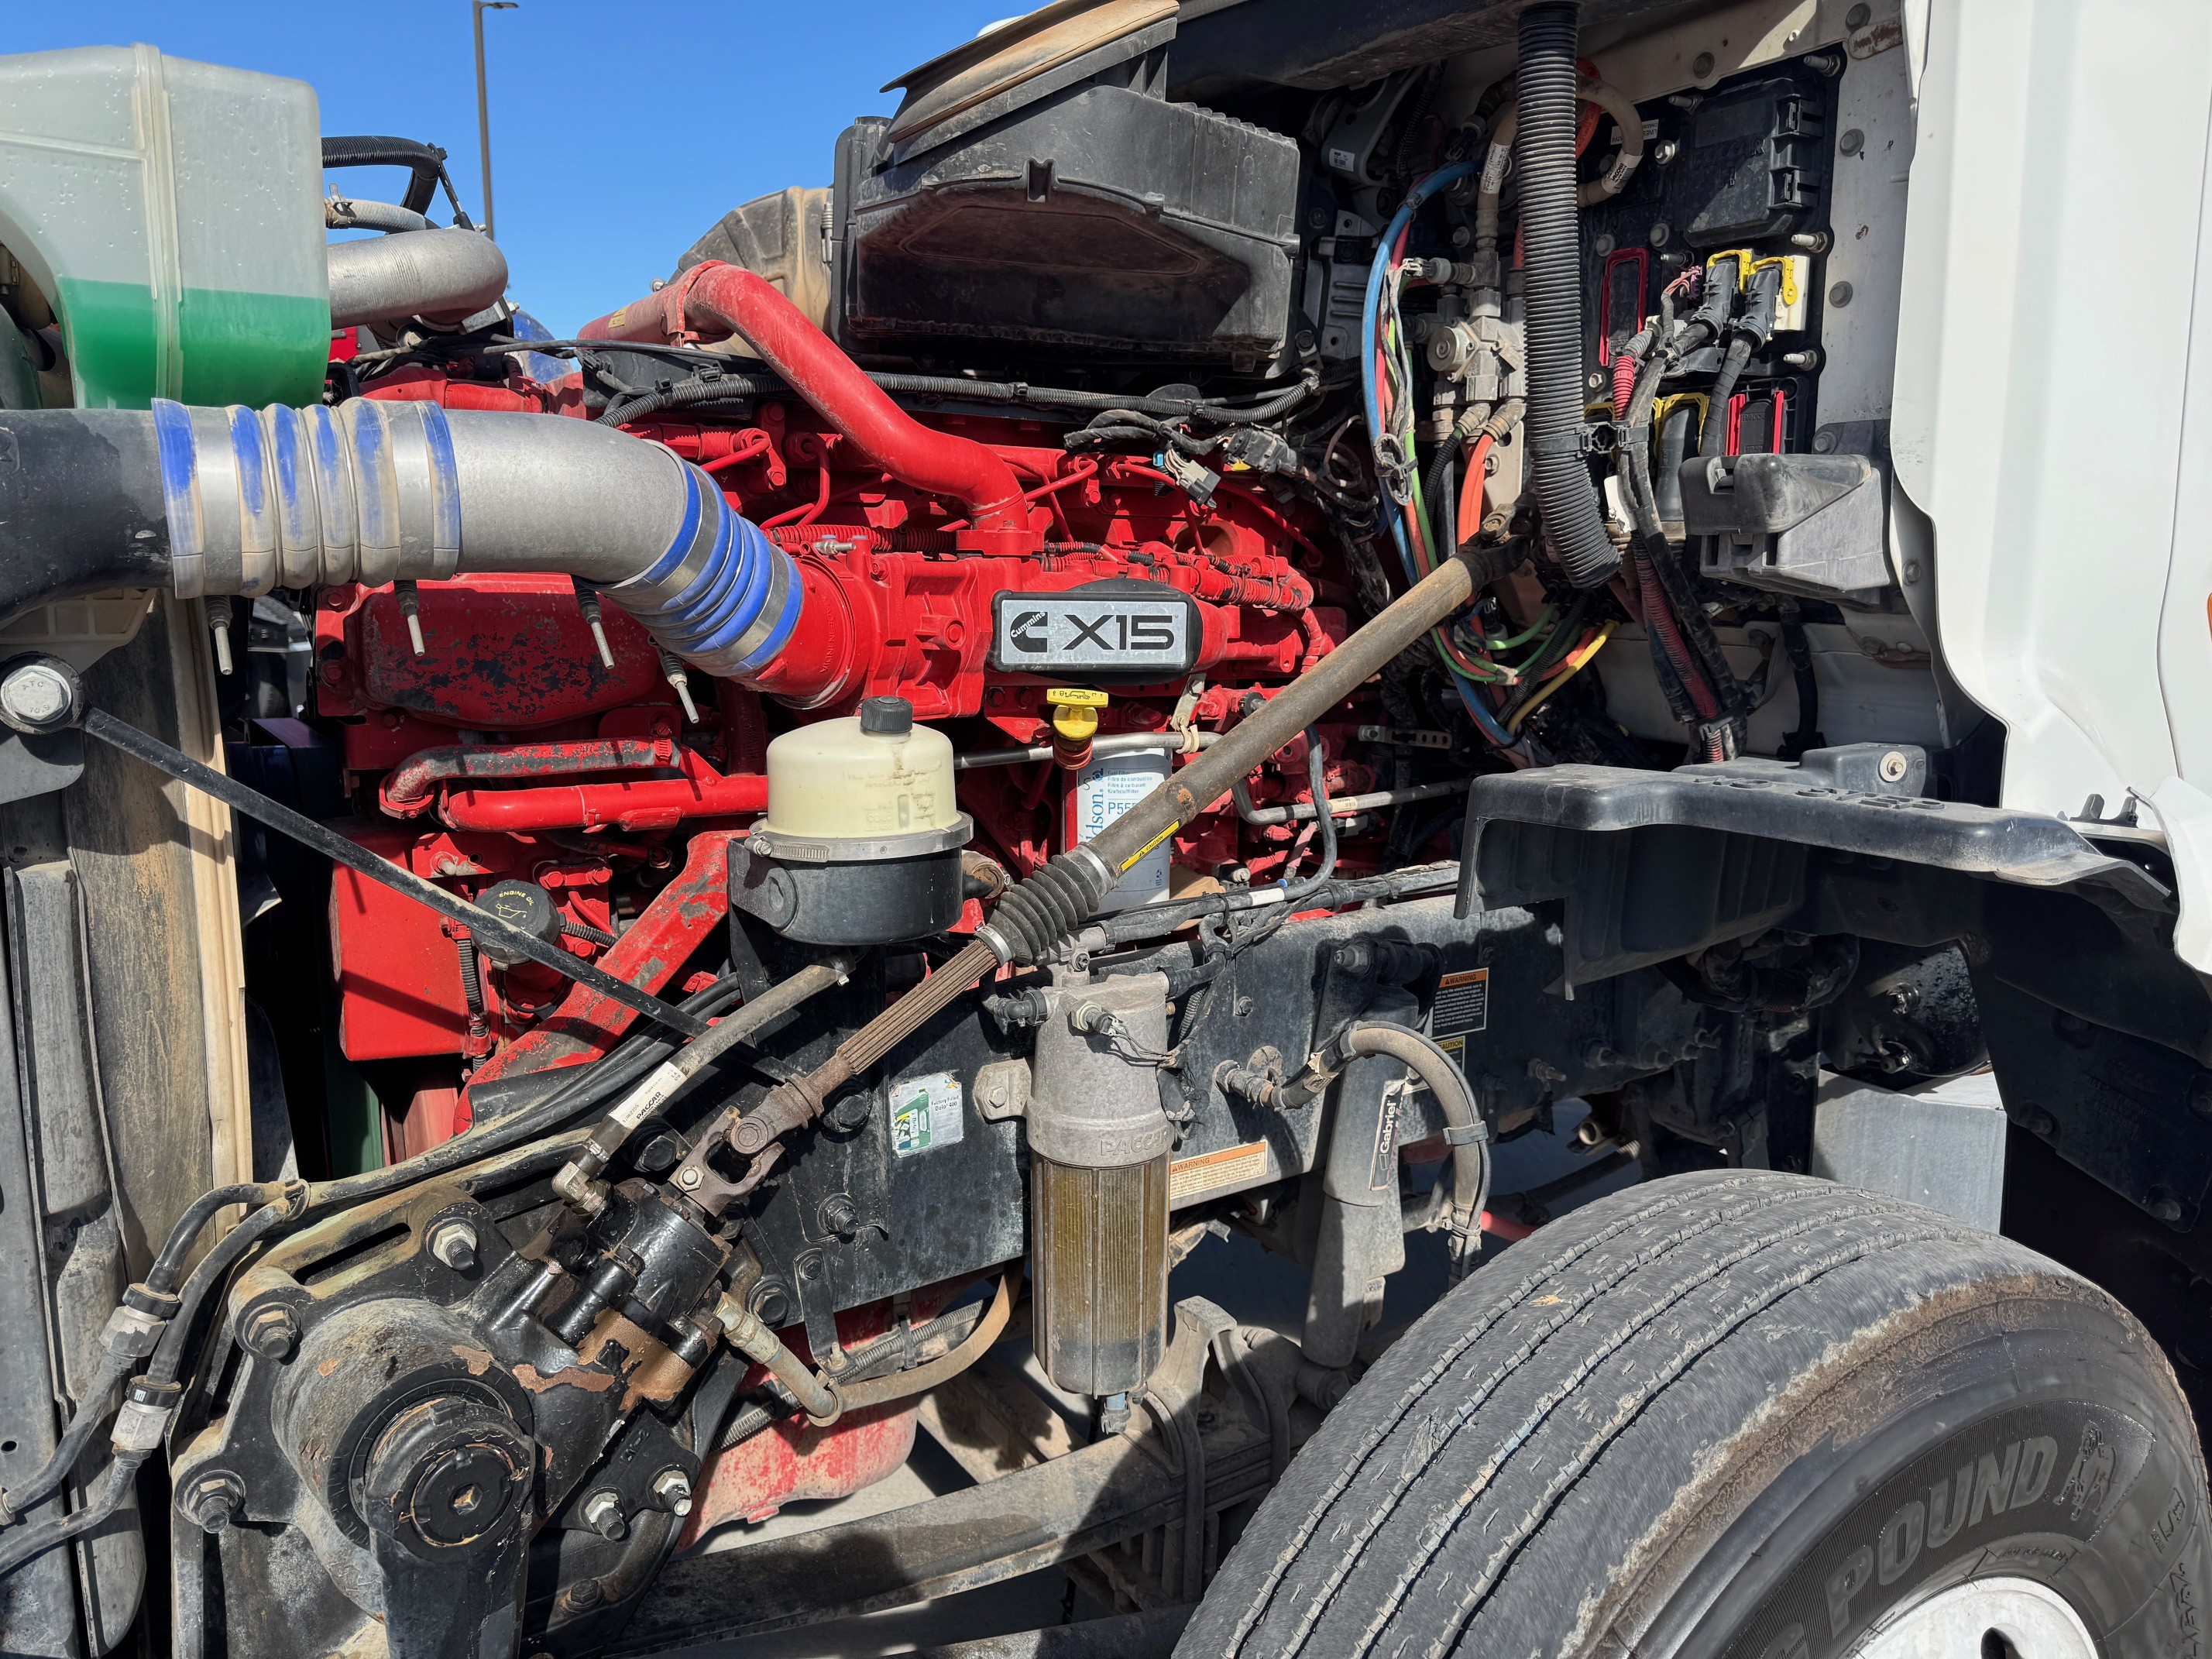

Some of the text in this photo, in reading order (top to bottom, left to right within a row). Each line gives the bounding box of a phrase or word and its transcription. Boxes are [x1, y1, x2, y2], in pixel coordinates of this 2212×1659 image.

[1010, 611, 1175, 651] Cummins X15
[820, 646, 834, 672] INDIA
[1694, 775, 1946, 809] NO STEP
[1146, 835, 1163, 851] CAUTION
[526, 896, 535, 906] OIL
[1450, 974, 1476, 984] WARNING
[636, 1091, 661, 1120] PACCAR
[1380, 1102, 1396, 1153] Gabriel
[1177, 1157, 1210, 1170] WARNING
[1826, 1435, 2059, 1640] POUND
